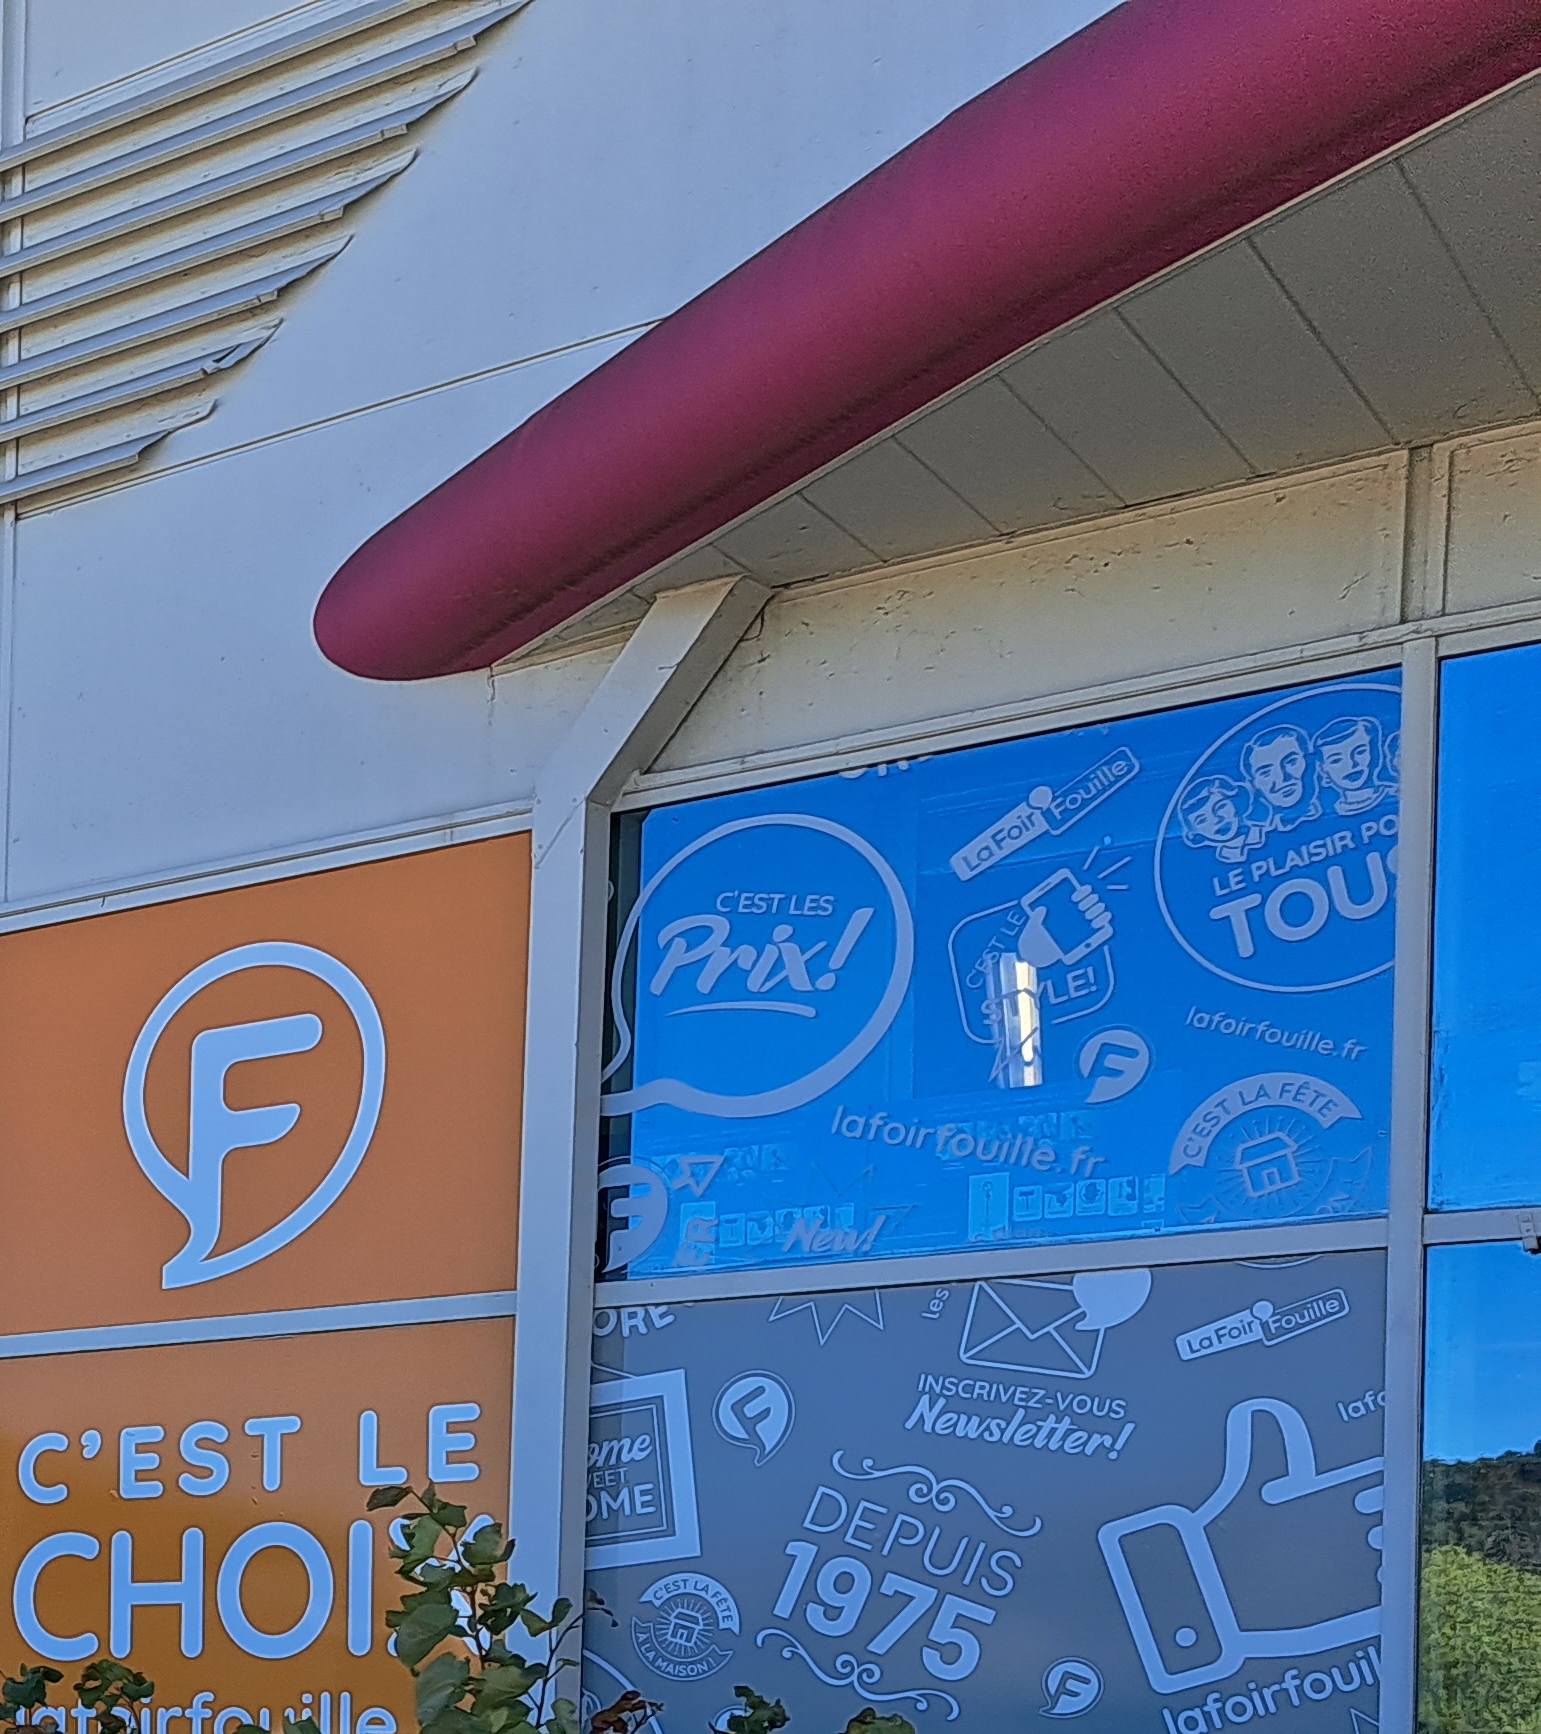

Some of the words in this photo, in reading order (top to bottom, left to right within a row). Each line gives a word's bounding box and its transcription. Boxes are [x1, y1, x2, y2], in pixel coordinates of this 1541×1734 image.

[1213, 869, 1246, 896] LE
[1252, 831, 1356, 883] PLAISIR
[1362, 815, 1398, 843] PO
[716, 891, 782, 916] C'EST
[789, 894, 835, 917] LES
[1210, 848, 1397, 958] TOU
[649, 907, 875, 996] Prix!
[965, 936, 1007, 990] C'EST
[1005, 909, 1026, 937] LE
[1185, 1006, 1367, 1061] lafoirfouille.fr
[831, 1105, 1106, 1179] lafoirfouille.fr
[1183, 1099, 1229, 1159] C'EST
[1238, 1085, 1270, 1106] LA
[1278, 1081, 1339, 1121] FÊTE
[781, 1216, 886, 1254] New!
[921, 1288, 949, 1320] les
[1267, 1298, 1340, 1334] Fouille
[904, 1393, 1136, 1460] Newsletter!
[918, 1373, 1127, 1419] INSCRIVEZ-VOUS
[19, 1416, 302, 1505] C'EST
[359, 1403, 480, 1488] LE
[587, 1434, 653, 1468] ome
[585, 1483, 656, 1522] OME
[802, 1485, 1022, 1597] DEPUIS
[654, 1578, 689, 1601] C'EST
[693, 1578, 709, 1594] LA
[710, 1591, 734, 1624] FÊTE
[773, 1540, 997, 1681] 1975
[643, 1643, 663, 1667] LA
[657, 1657, 708, 1677] MAISON
